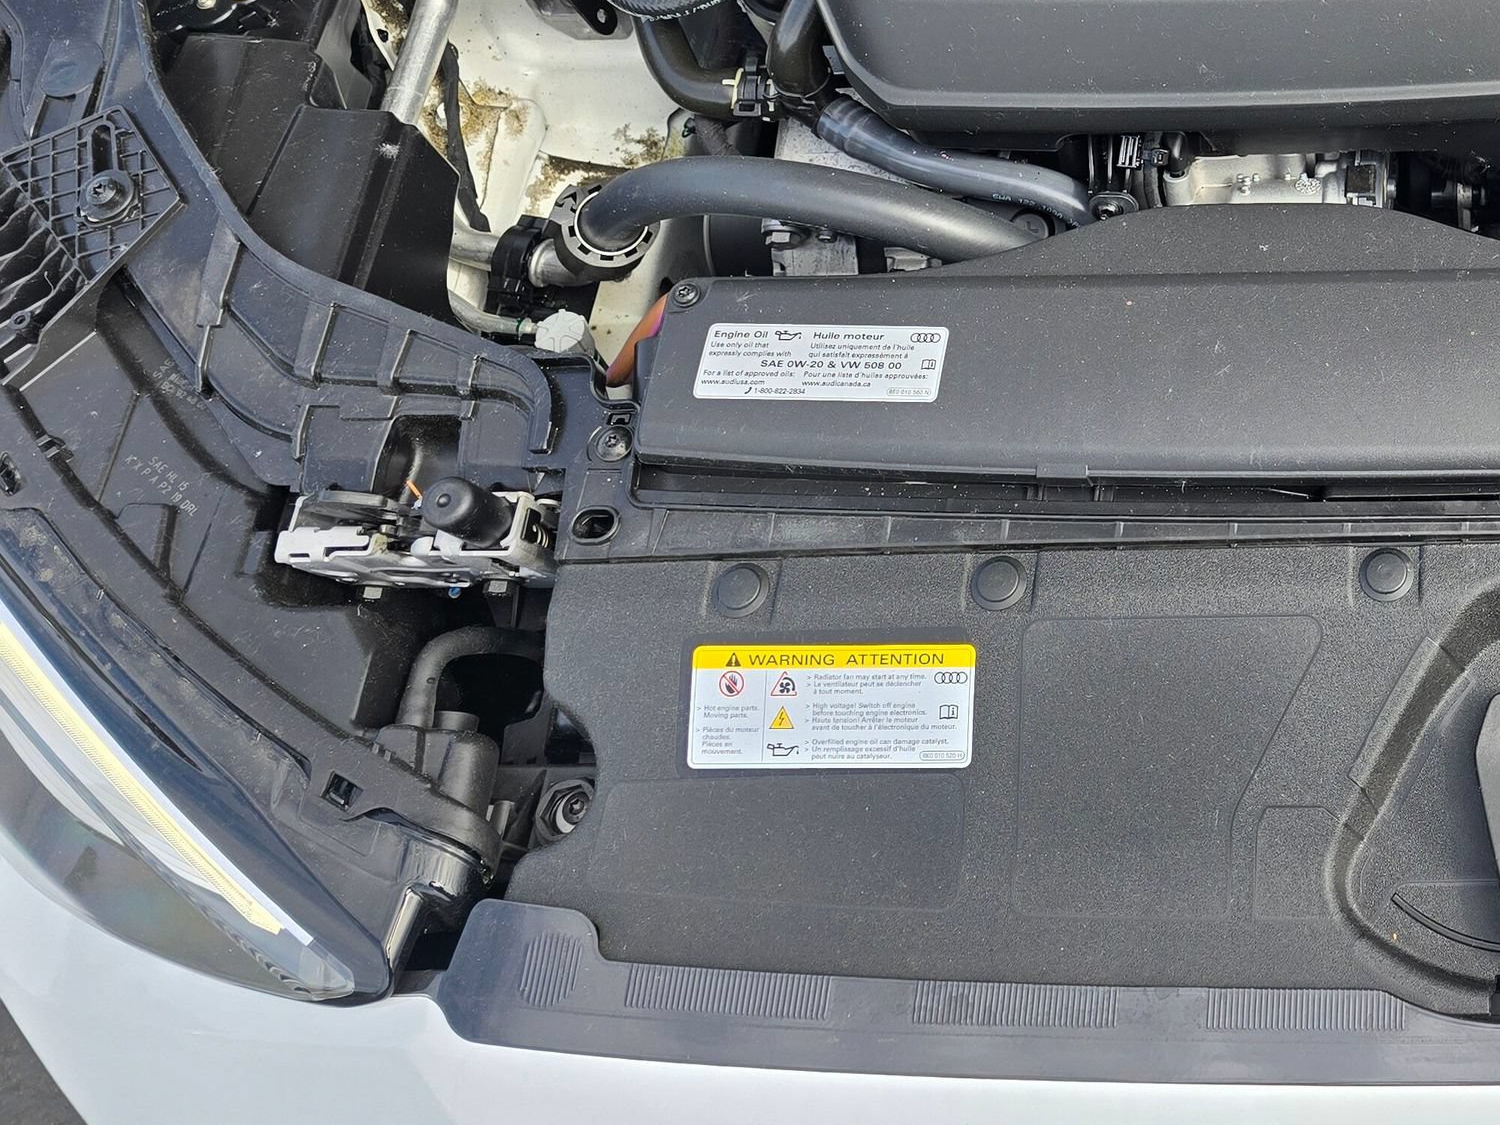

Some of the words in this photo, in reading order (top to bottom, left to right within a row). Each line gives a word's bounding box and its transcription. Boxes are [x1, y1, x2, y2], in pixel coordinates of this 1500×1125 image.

[714, 331, 750, 339] Engine
[760, 359, 784, 368] SAE
[787, 360, 824, 369] 0W-20
[827, 361, 837, 369] &
[841, 361, 862, 369] VW
[864, 361, 885, 370] 508
[888, 362, 902, 370] 00
[854, 371, 882, 379] d'huiles
[148, 456, 164, 473] SAE
[167, 470, 176, 484] HL
[179, 482, 190, 495] 15
[150, 475, 157, 484] A
[158, 481, 171, 494] P2
[171, 491, 182, 503] 19
[180, 498, 199, 517] DRL
[749, 654, 835, 666] WARNING
[846, 653, 944, 665] ATTENTION
[875, 724, 918, 732] l'électronique
[922, 738, 949, 746] catalyst.
[823, 746, 863, 754] remplissage
